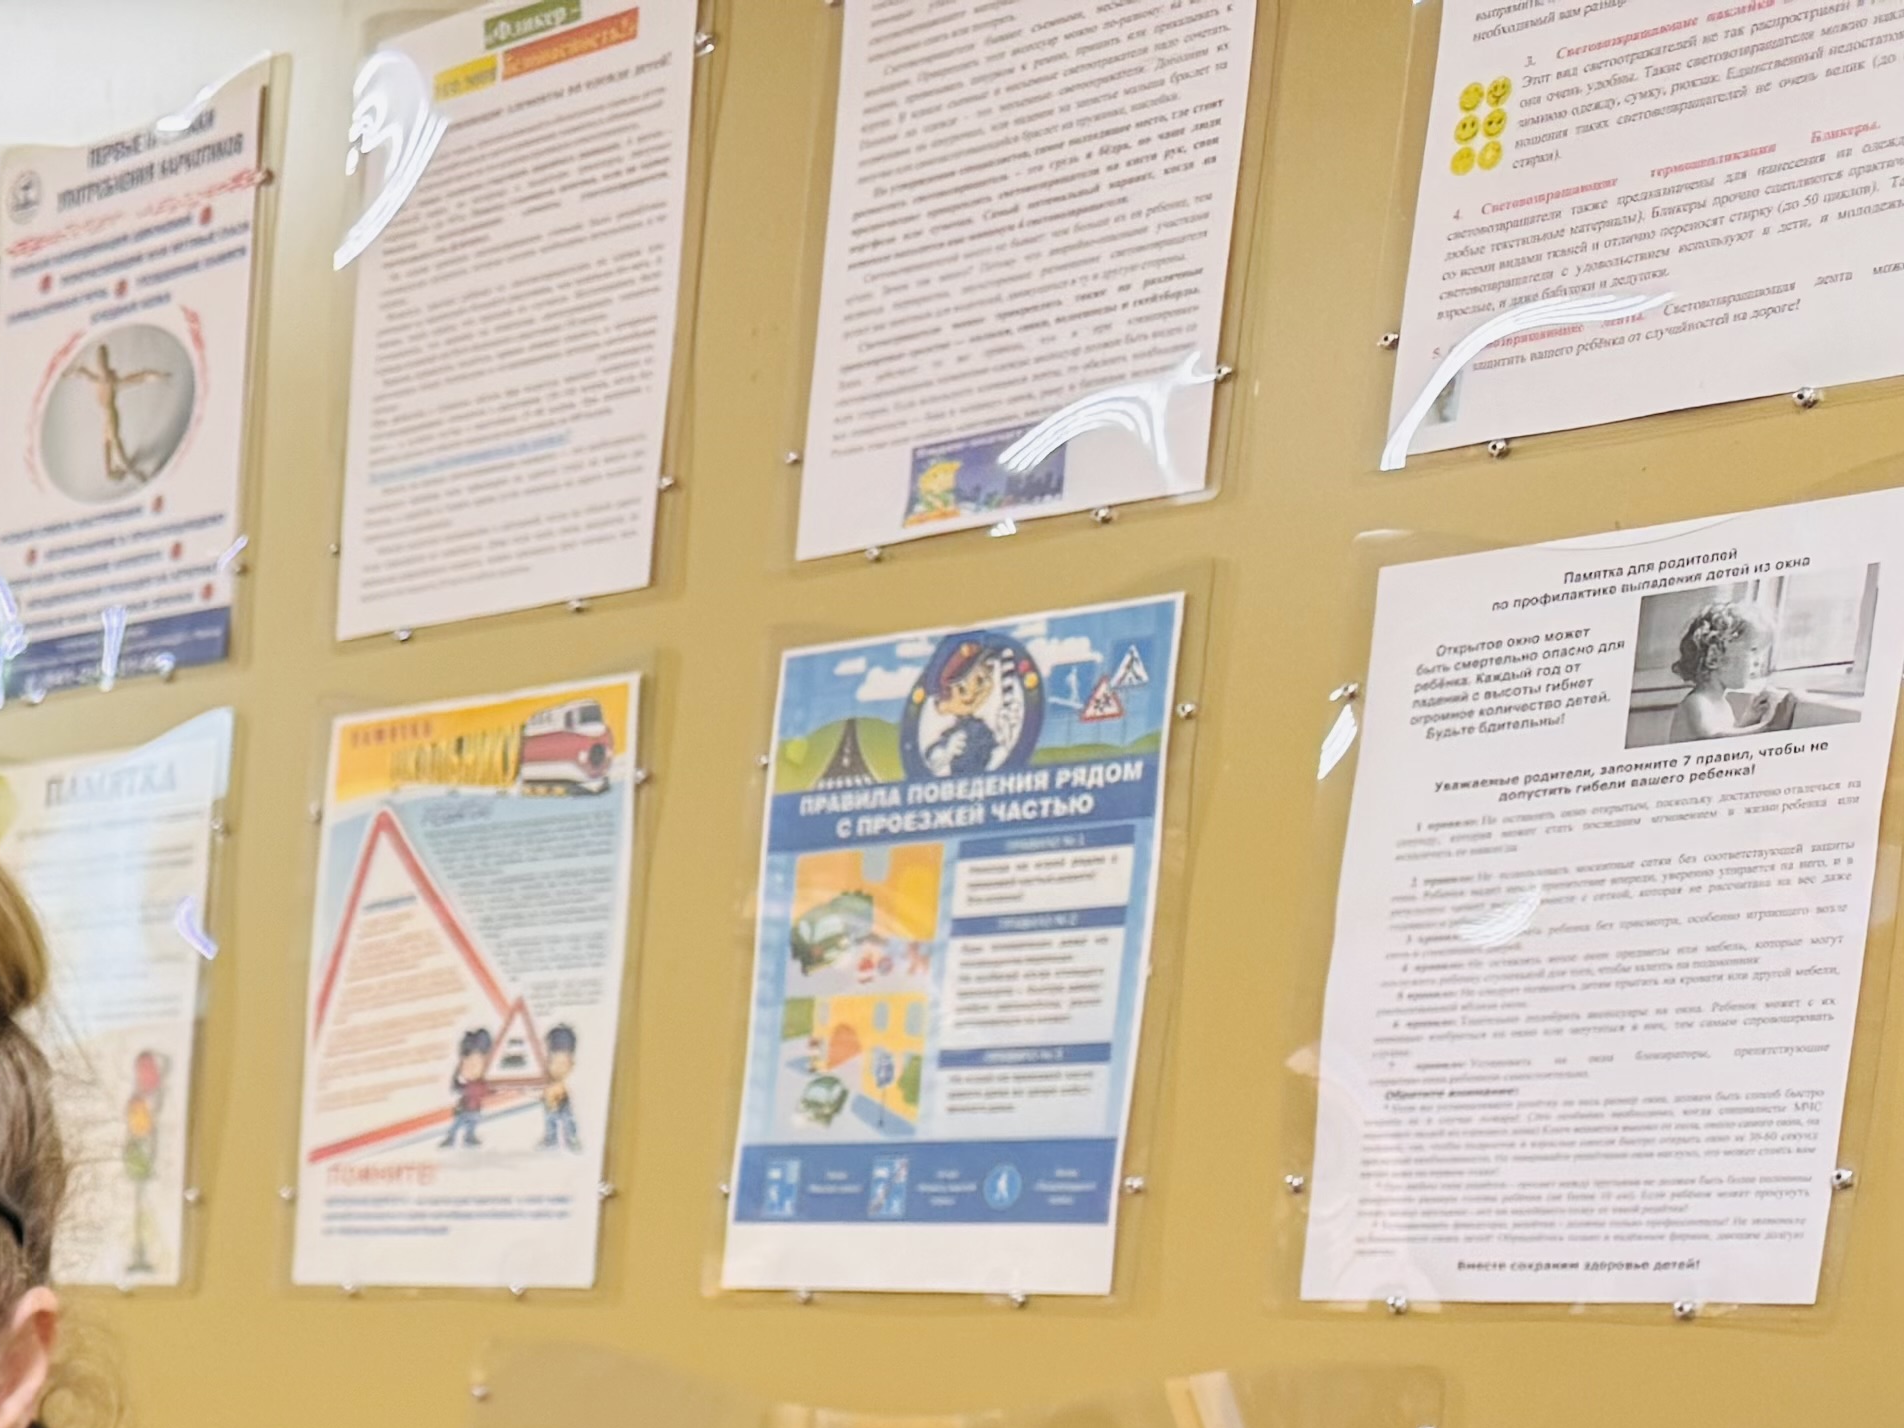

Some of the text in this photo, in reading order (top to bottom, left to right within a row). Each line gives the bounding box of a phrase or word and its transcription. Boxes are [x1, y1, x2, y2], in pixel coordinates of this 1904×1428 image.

[1492, 556, 1810, 612] по профилактике выпадения детей из окна
[1563, 547, 1737, 585] Памятка для родителей
[1415, 640, 1625, 675] быть смертельно опасно для
[1435, 627, 1590, 659] Открытое окно может
[1472, 691, 1479, 701] с
[1483, 684, 1541, 700] высоты
[1545, 675, 1593, 692] гибнет
[1475, 666, 1532, 685] Каждый
[1536, 665, 1561, 677] год
[1565, 662, 1581, 673] от
[1478, 698, 1562, 717] количество
[1565, 690, 1610, 708] детей.
[1424, 712, 1566, 743] Будьте бдительны!
[1523, 764, 1595, 786] родители,
[1599, 756, 1678, 777] запомните
[1681, 755, 1691, 766] 7
[1695, 748, 1754, 768] правил,
[1758, 740, 1806, 759] чтобы
[1810, 740, 1828, 752] не
[800, 761, 1143, 816] ПРАВИЛА ПОВЕДЕНИЯ РЯДОМ
[1498, 763, 1756, 804] допустить гибели вашего ребенка!
[836, 794, 1094, 838] С ПРОЕЗЖЕЙ ЧАСТЬЮ
